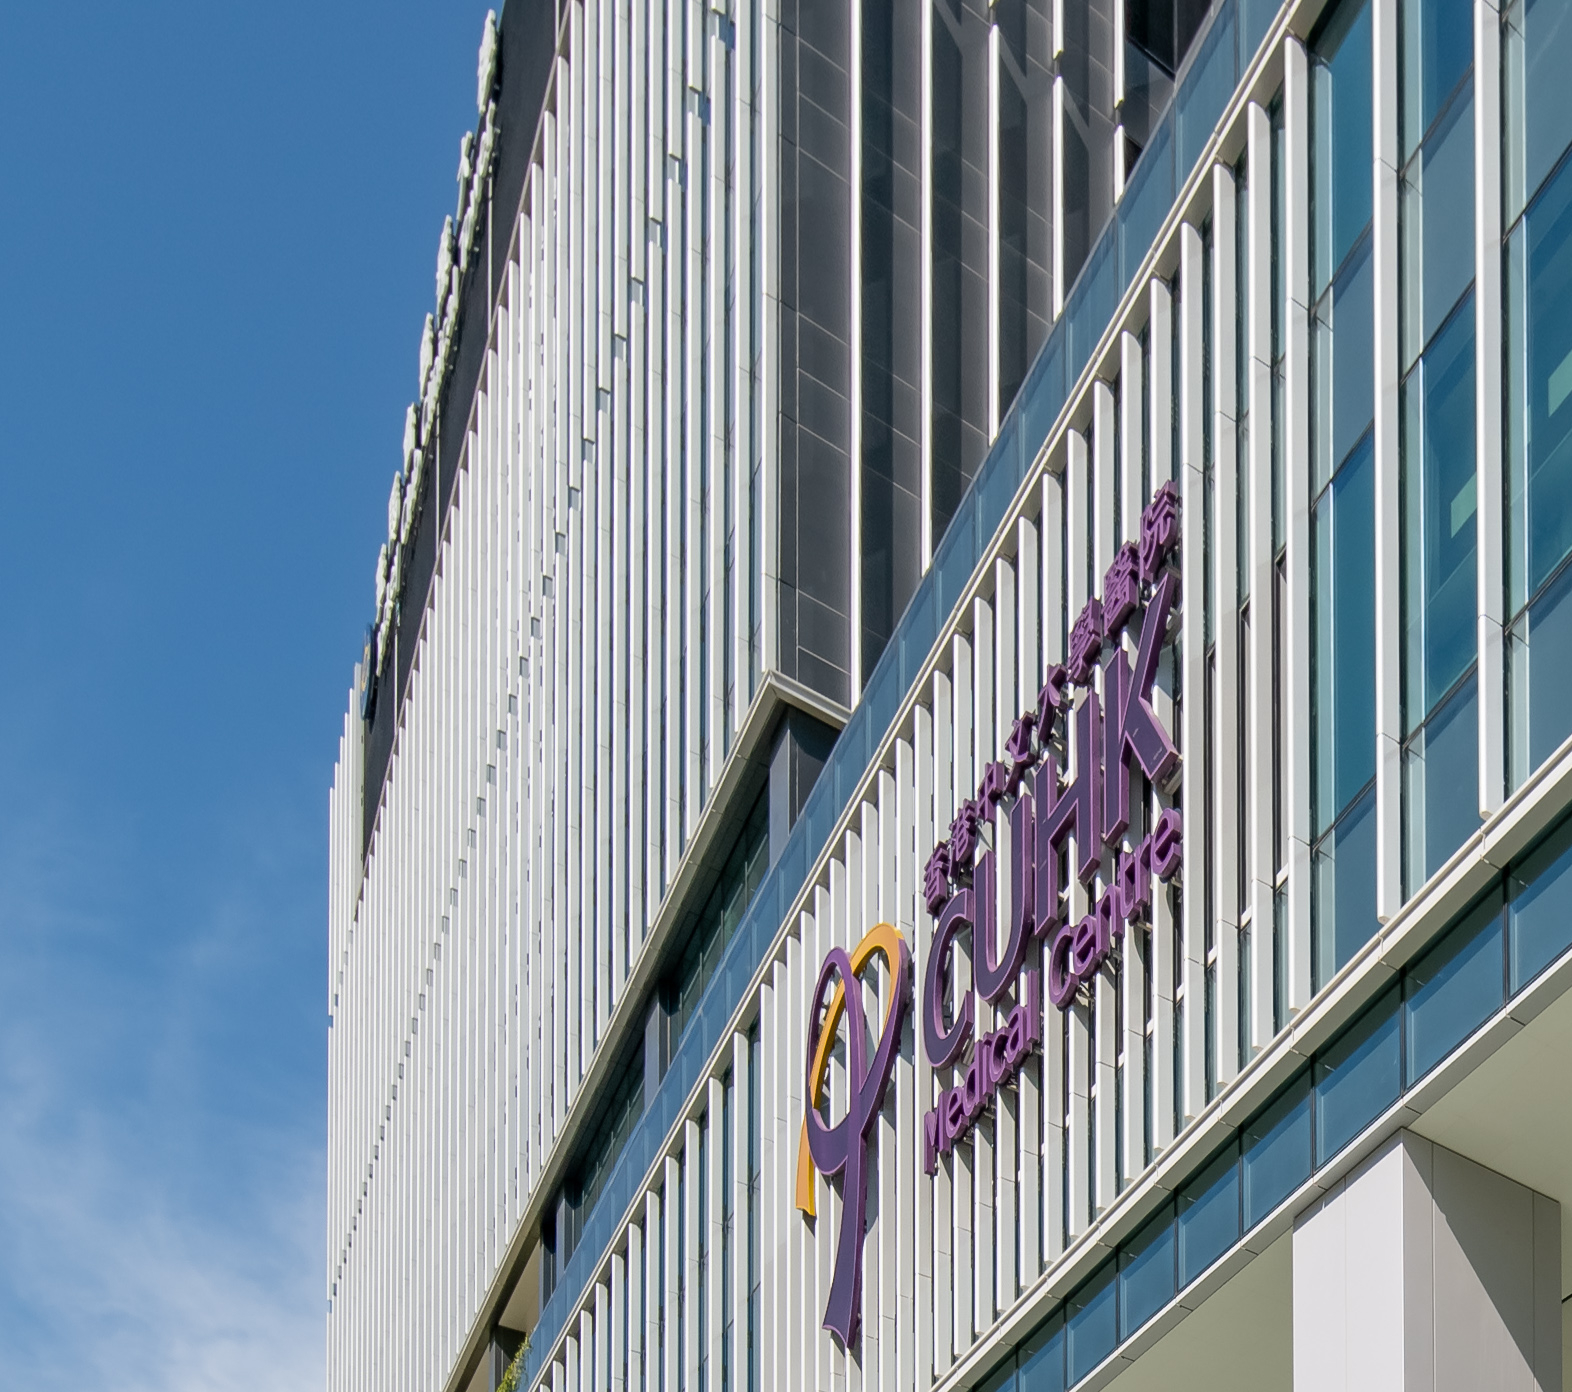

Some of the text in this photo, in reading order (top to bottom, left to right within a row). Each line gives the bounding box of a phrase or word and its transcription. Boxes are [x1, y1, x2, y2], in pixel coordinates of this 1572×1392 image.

[923, 573, 1180, 1069] CUHK
[924, 480, 1177, 915] 香港中文大學醫院
[924, 807, 1182, 1175] Medical Centre
